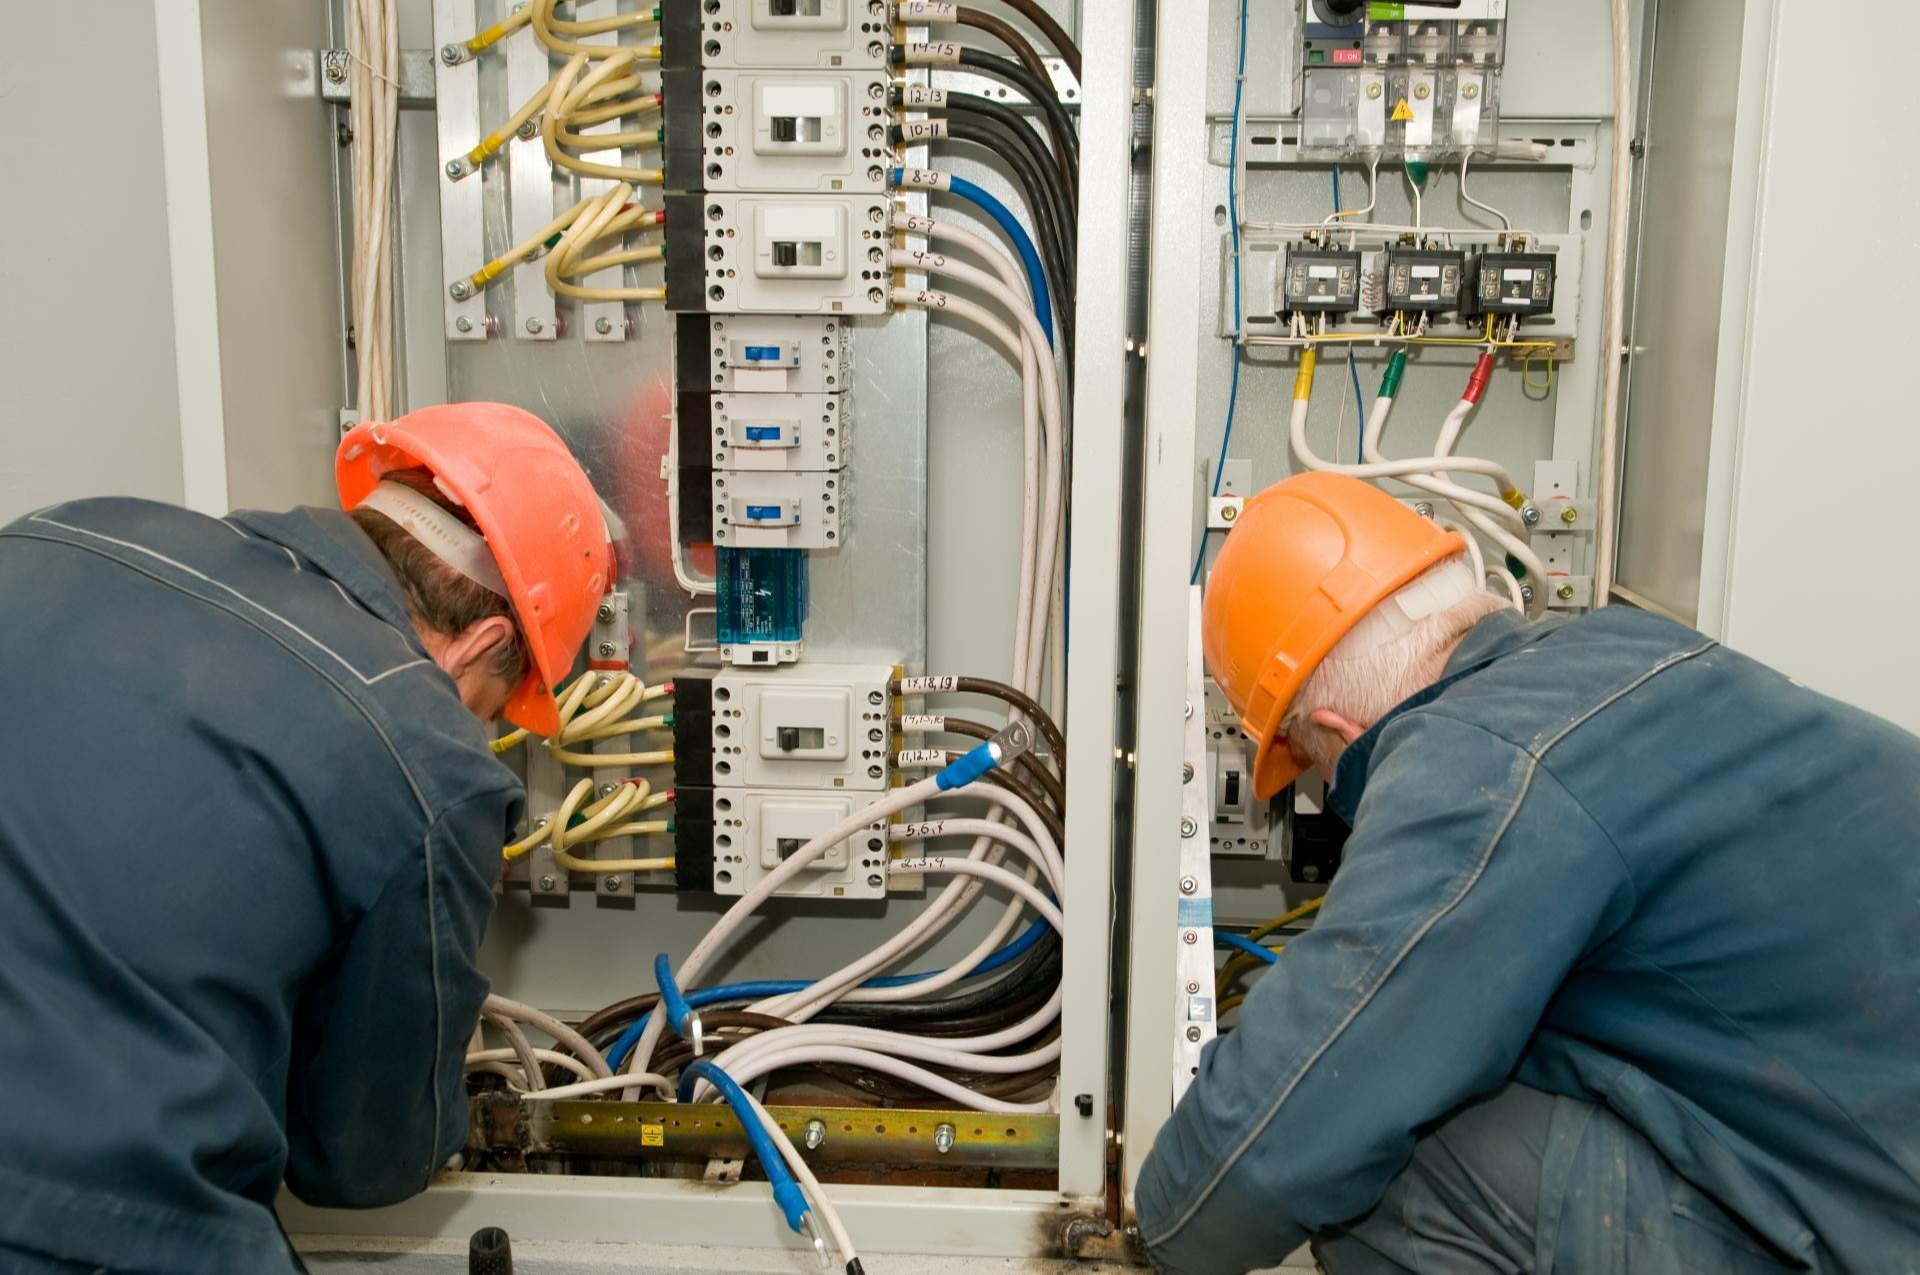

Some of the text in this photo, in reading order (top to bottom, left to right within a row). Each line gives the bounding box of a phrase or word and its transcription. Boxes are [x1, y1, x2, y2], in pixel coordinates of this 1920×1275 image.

[910, 90, 942, 104] 12-13
[910, 123, 939, 137] 10-11
[912, 169, 939, 185] 8-9
[907, 216, 936, 233] 6-7
[917, 290, 946, 308] 2-3
